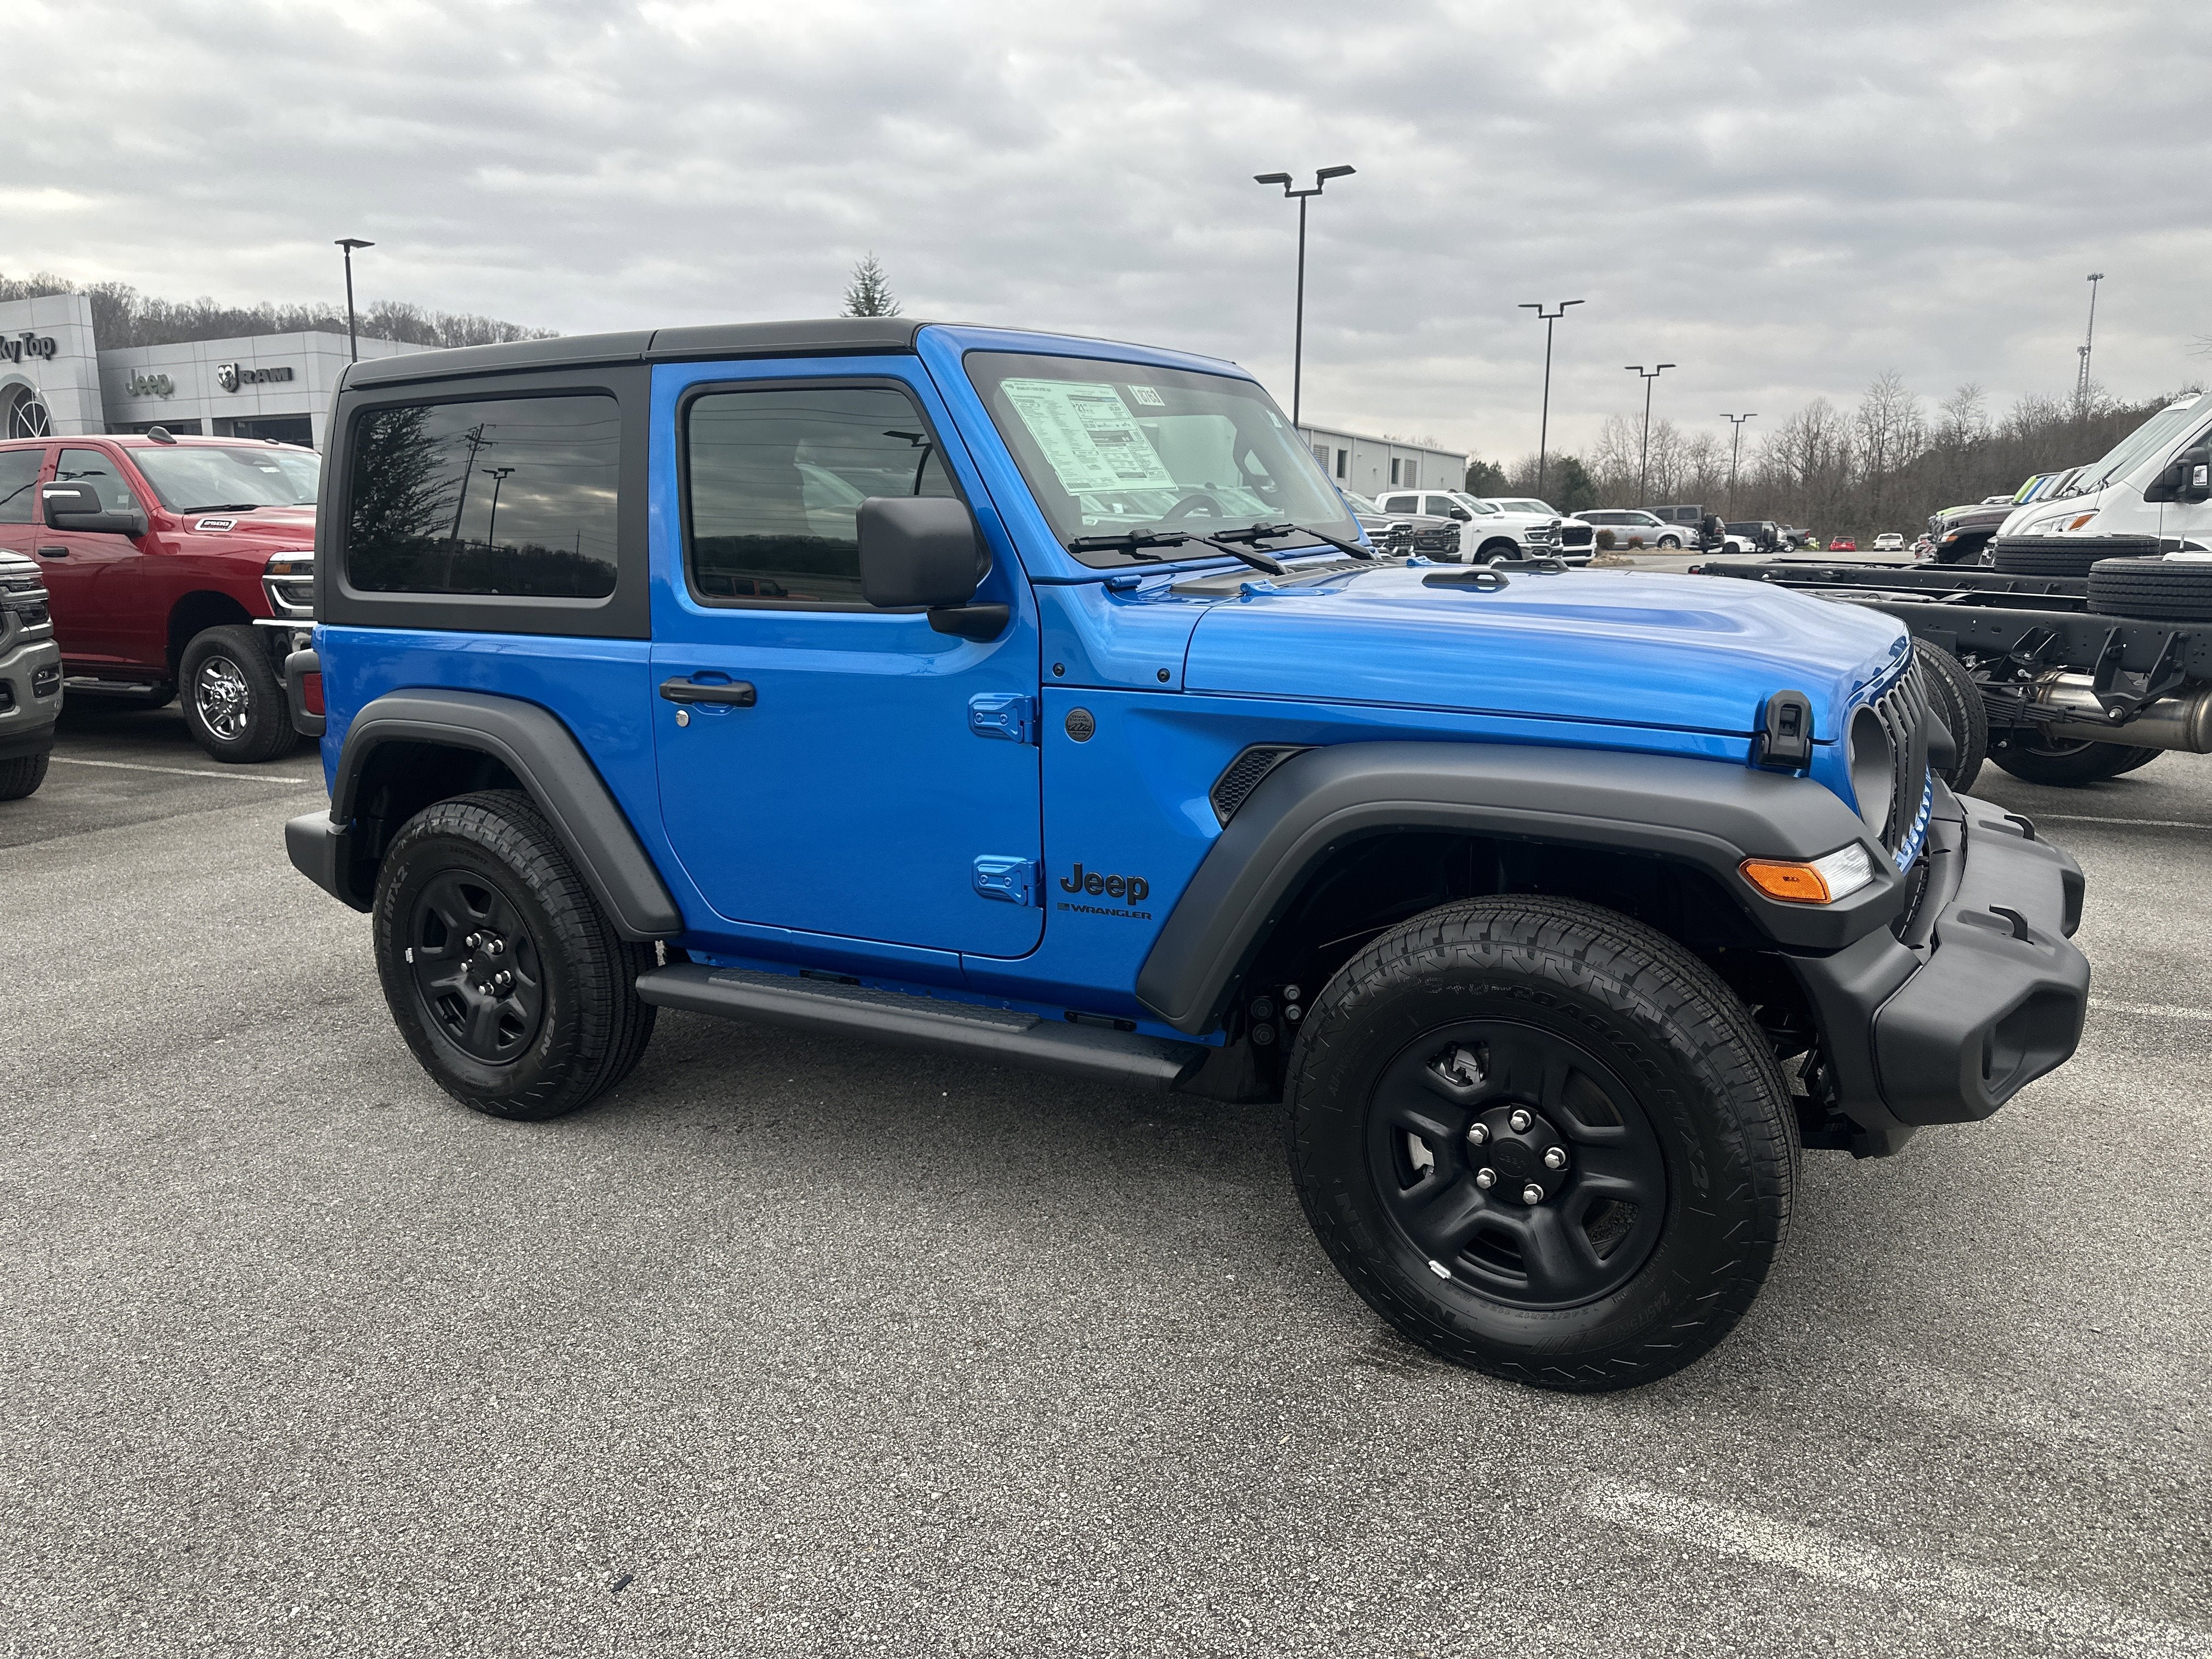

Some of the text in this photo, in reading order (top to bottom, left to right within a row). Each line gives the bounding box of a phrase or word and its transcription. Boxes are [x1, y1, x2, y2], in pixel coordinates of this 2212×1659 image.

[19, 332, 55, 360] Top
[126, 369, 173, 399] Jeep
[239, 367, 293, 383] RAM
[1137, 390, 1161, 403] 8763
[384, 866, 408, 919] HTX2
[1060, 862, 1149, 906] Jeep
[1070, 904, 1153, 921] WRANGLER
[1334, 1192, 1457, 1328] NEXEN
[1515, 1307, 1589, 1321] 245/75R17
